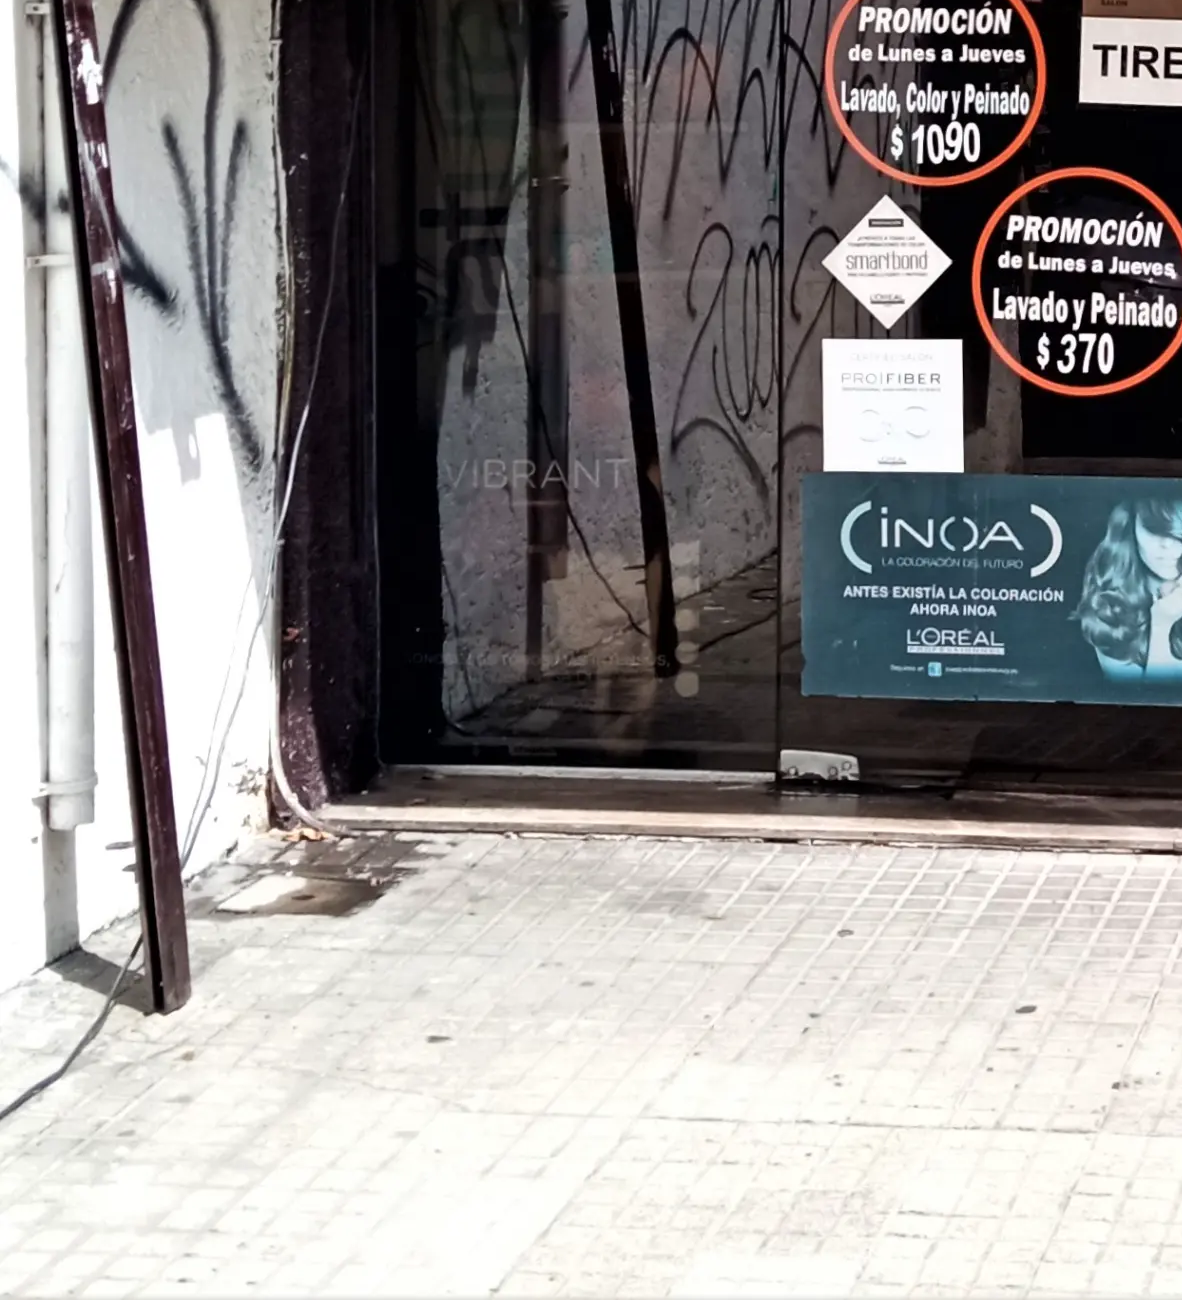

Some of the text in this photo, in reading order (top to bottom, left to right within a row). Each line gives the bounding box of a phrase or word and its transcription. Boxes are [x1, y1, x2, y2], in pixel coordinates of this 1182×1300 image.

[858, 1, 1012, 35] PROMOCIÓN
[848, 44, 1026, 63] de Lunes a Jueves
[840, 80, 1030, 121] Lavado, Color y Peinado
[890, 120, 981, 165] $ 1090
[1006, 212, 1163, 248] PROMOCIÓN
[845, 249, 929, 271] smartbond
[998, 251, 1176, 277] de Lunes a Jueves
[993, 287, 1178, 331] Lavado y Peinado
[1037, 333, 1114, 375] $ 370
[444, 459, 632, 489] VIBRANT
[881, 556, 894, 566] LA
[896, 555, 960, 568] COLORACIÓN
[983, 559, 1024, 569] FUTURO
[843, 584, 1064, 602] ANTES EXISTÍA LA COLORACIÓN
[910, 604, 997, 617] AHORA INOA
[907, 627, 1005, 647] L'ORÉAL
